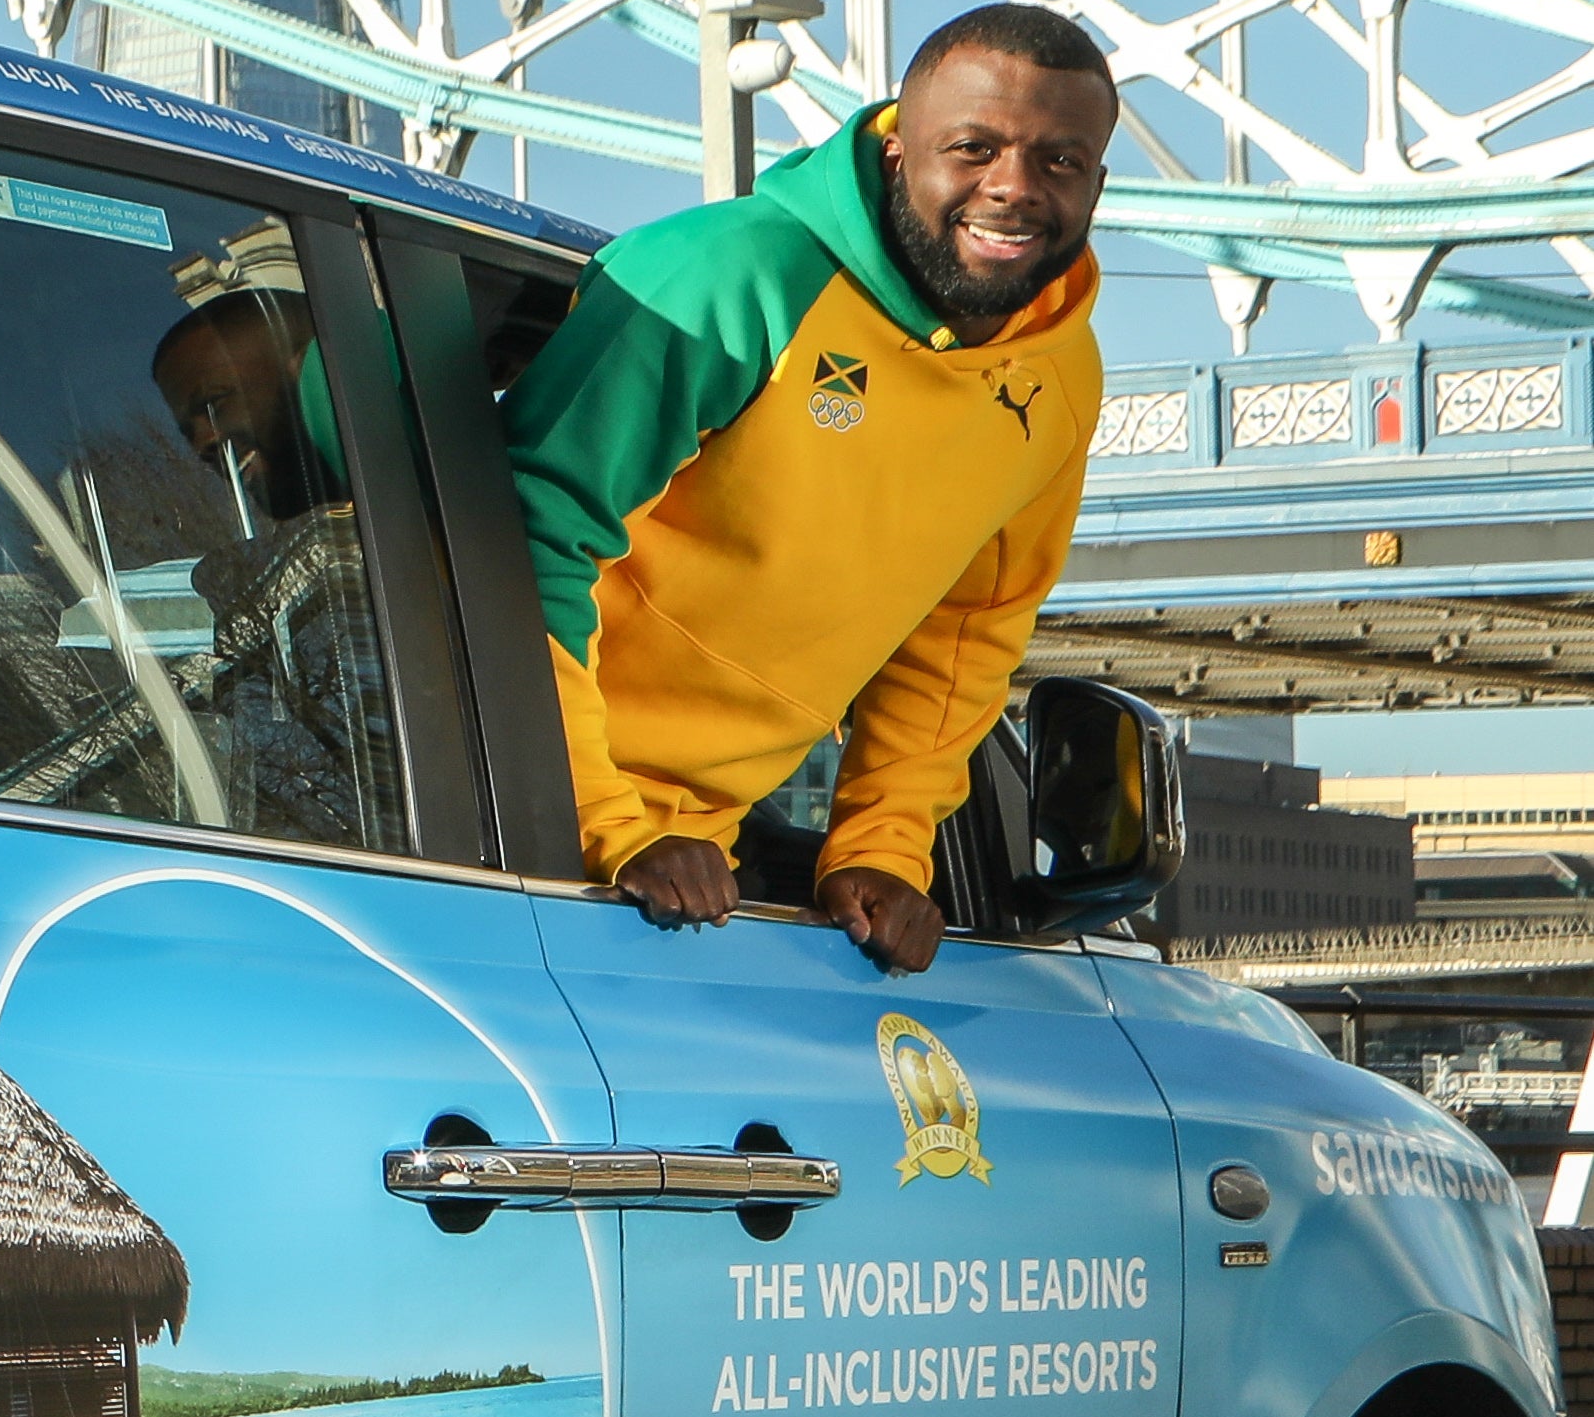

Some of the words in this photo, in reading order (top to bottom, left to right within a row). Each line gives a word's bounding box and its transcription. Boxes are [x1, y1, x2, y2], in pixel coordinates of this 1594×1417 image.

[90, 83, 148, 112] THE
[149, 96, 271, 144] BAHAMAS
[283, 134, 398, 178] GRENADA
[407, 170, 533, 220] BARBADOS
[15, 187, 33, 200] This
[34, 192, 49, 202] taxi
[69, 199, 98, 213] accepts
[19, 203, 36, 214] card
[38, 207, 75, 221] payments
[77, 212, 113, 230] including
[880, 1015, 921, 1041] TRAVEL
[881, 1043, 912, 1128] WORLD
[927, 1037, 977, 1124] AWARDS
[912, 1126, 971, 1153] WINNER
[1227, 1252, 1269, 1264] VISTA
[728, 1263, 807, 1321] THE
[818, 1259, 990, 1320] WORLD'S
[1000, 1256, 1148, 1313] LEADING
[711, 1345, 997, 1414] ALL-INCLUSIVE
[1007, 1338, 1158, 1398] RESORTS
